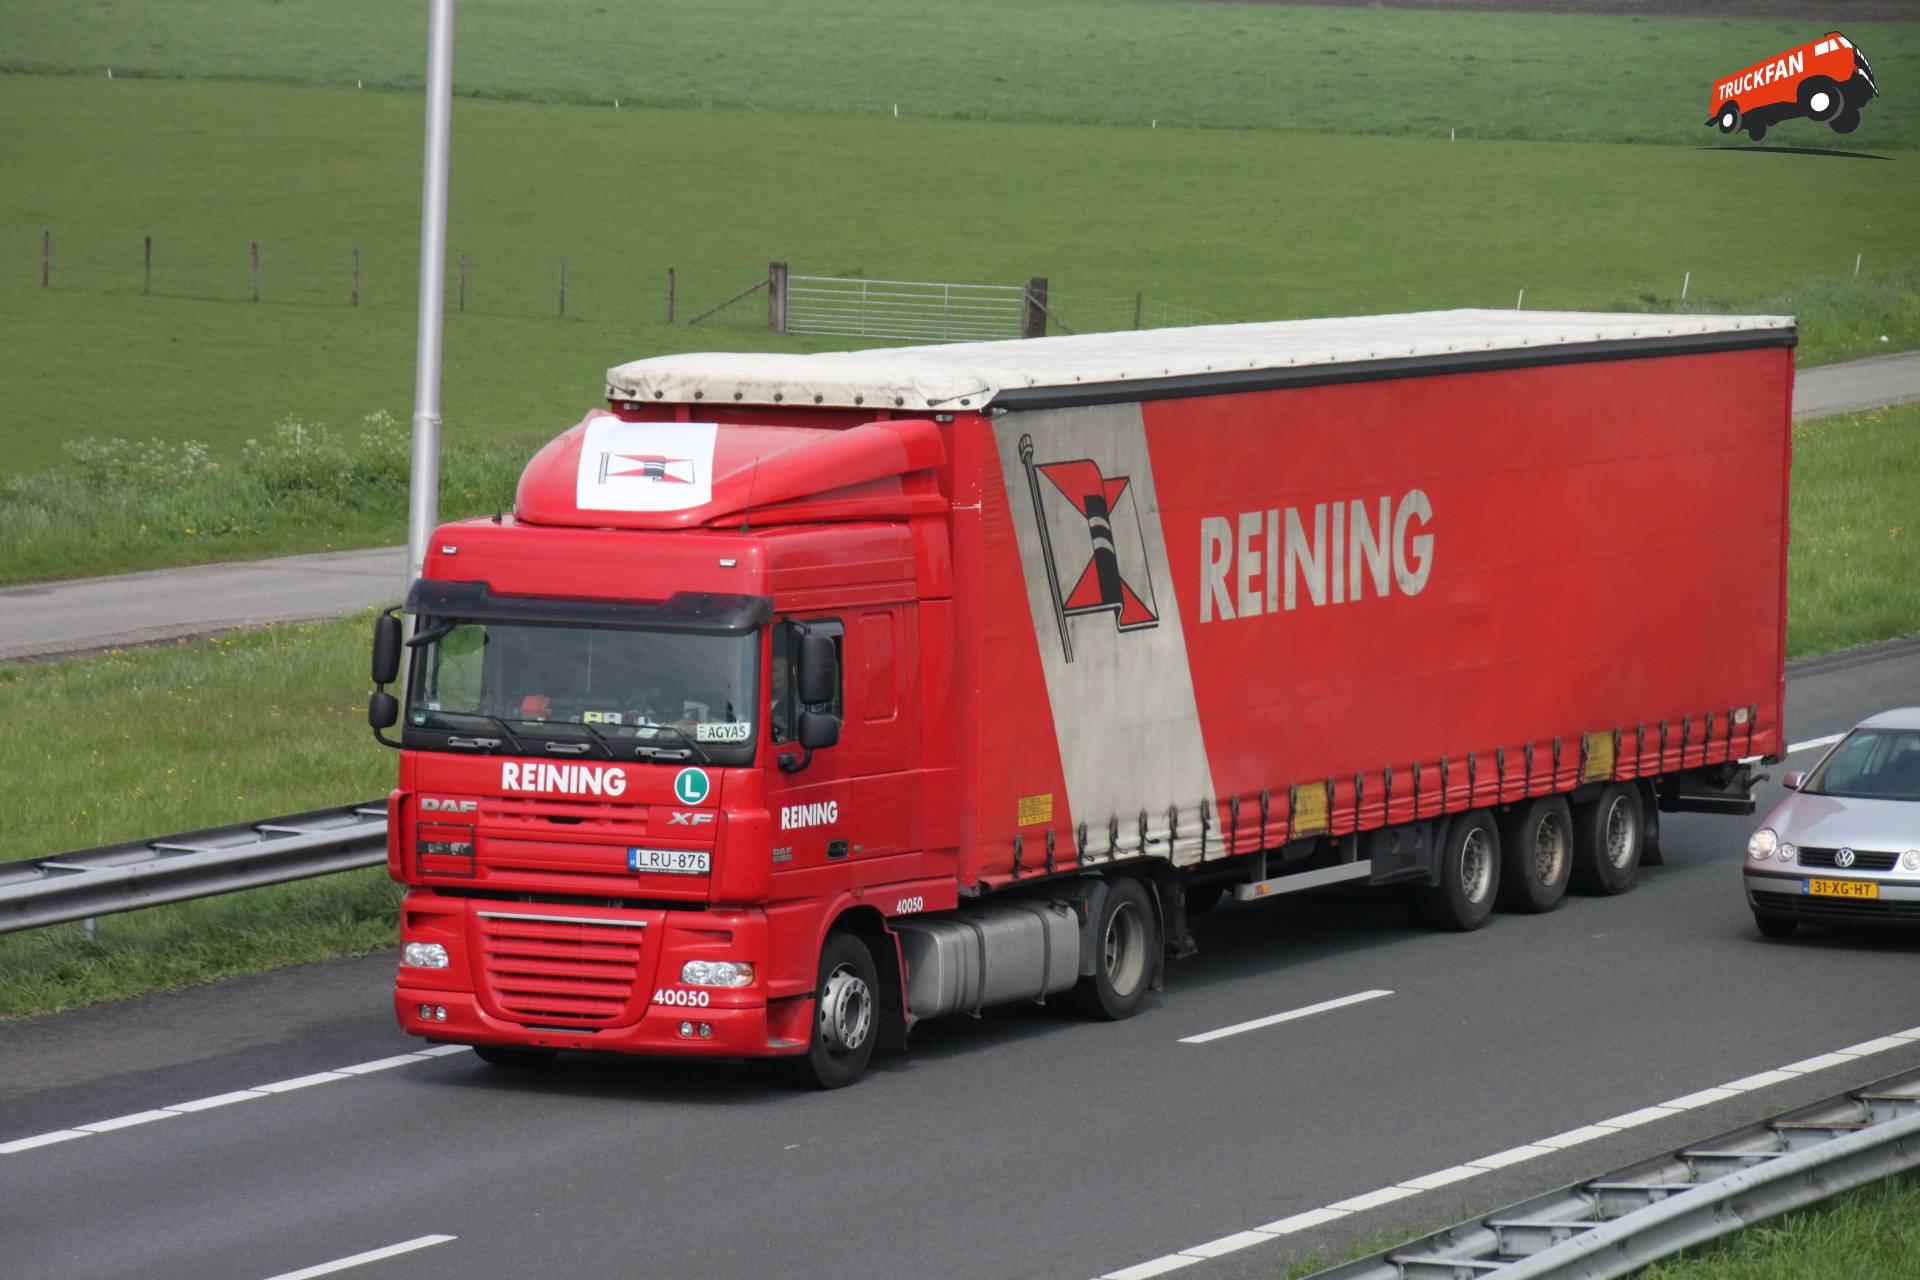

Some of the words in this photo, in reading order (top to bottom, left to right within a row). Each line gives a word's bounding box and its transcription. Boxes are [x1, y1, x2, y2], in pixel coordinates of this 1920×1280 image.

[1200, 489, 1434, 623] REINING
[708, 726, 746, 738] AGYAS
[502, 762, 626, 796] REINING
[685, 774, 700, 797] L
[421, 798, 477, 812] DAF
[666, 812, 714, 826] XF
[781, 801, 838, 830] REINING
[640, 852, 706, 869] LRU-876
[1815, 881, 1871, 896] 31-XG-HT
[896, 896, 923, 914] 40050
[653, 989, 709, 1007] 40050
